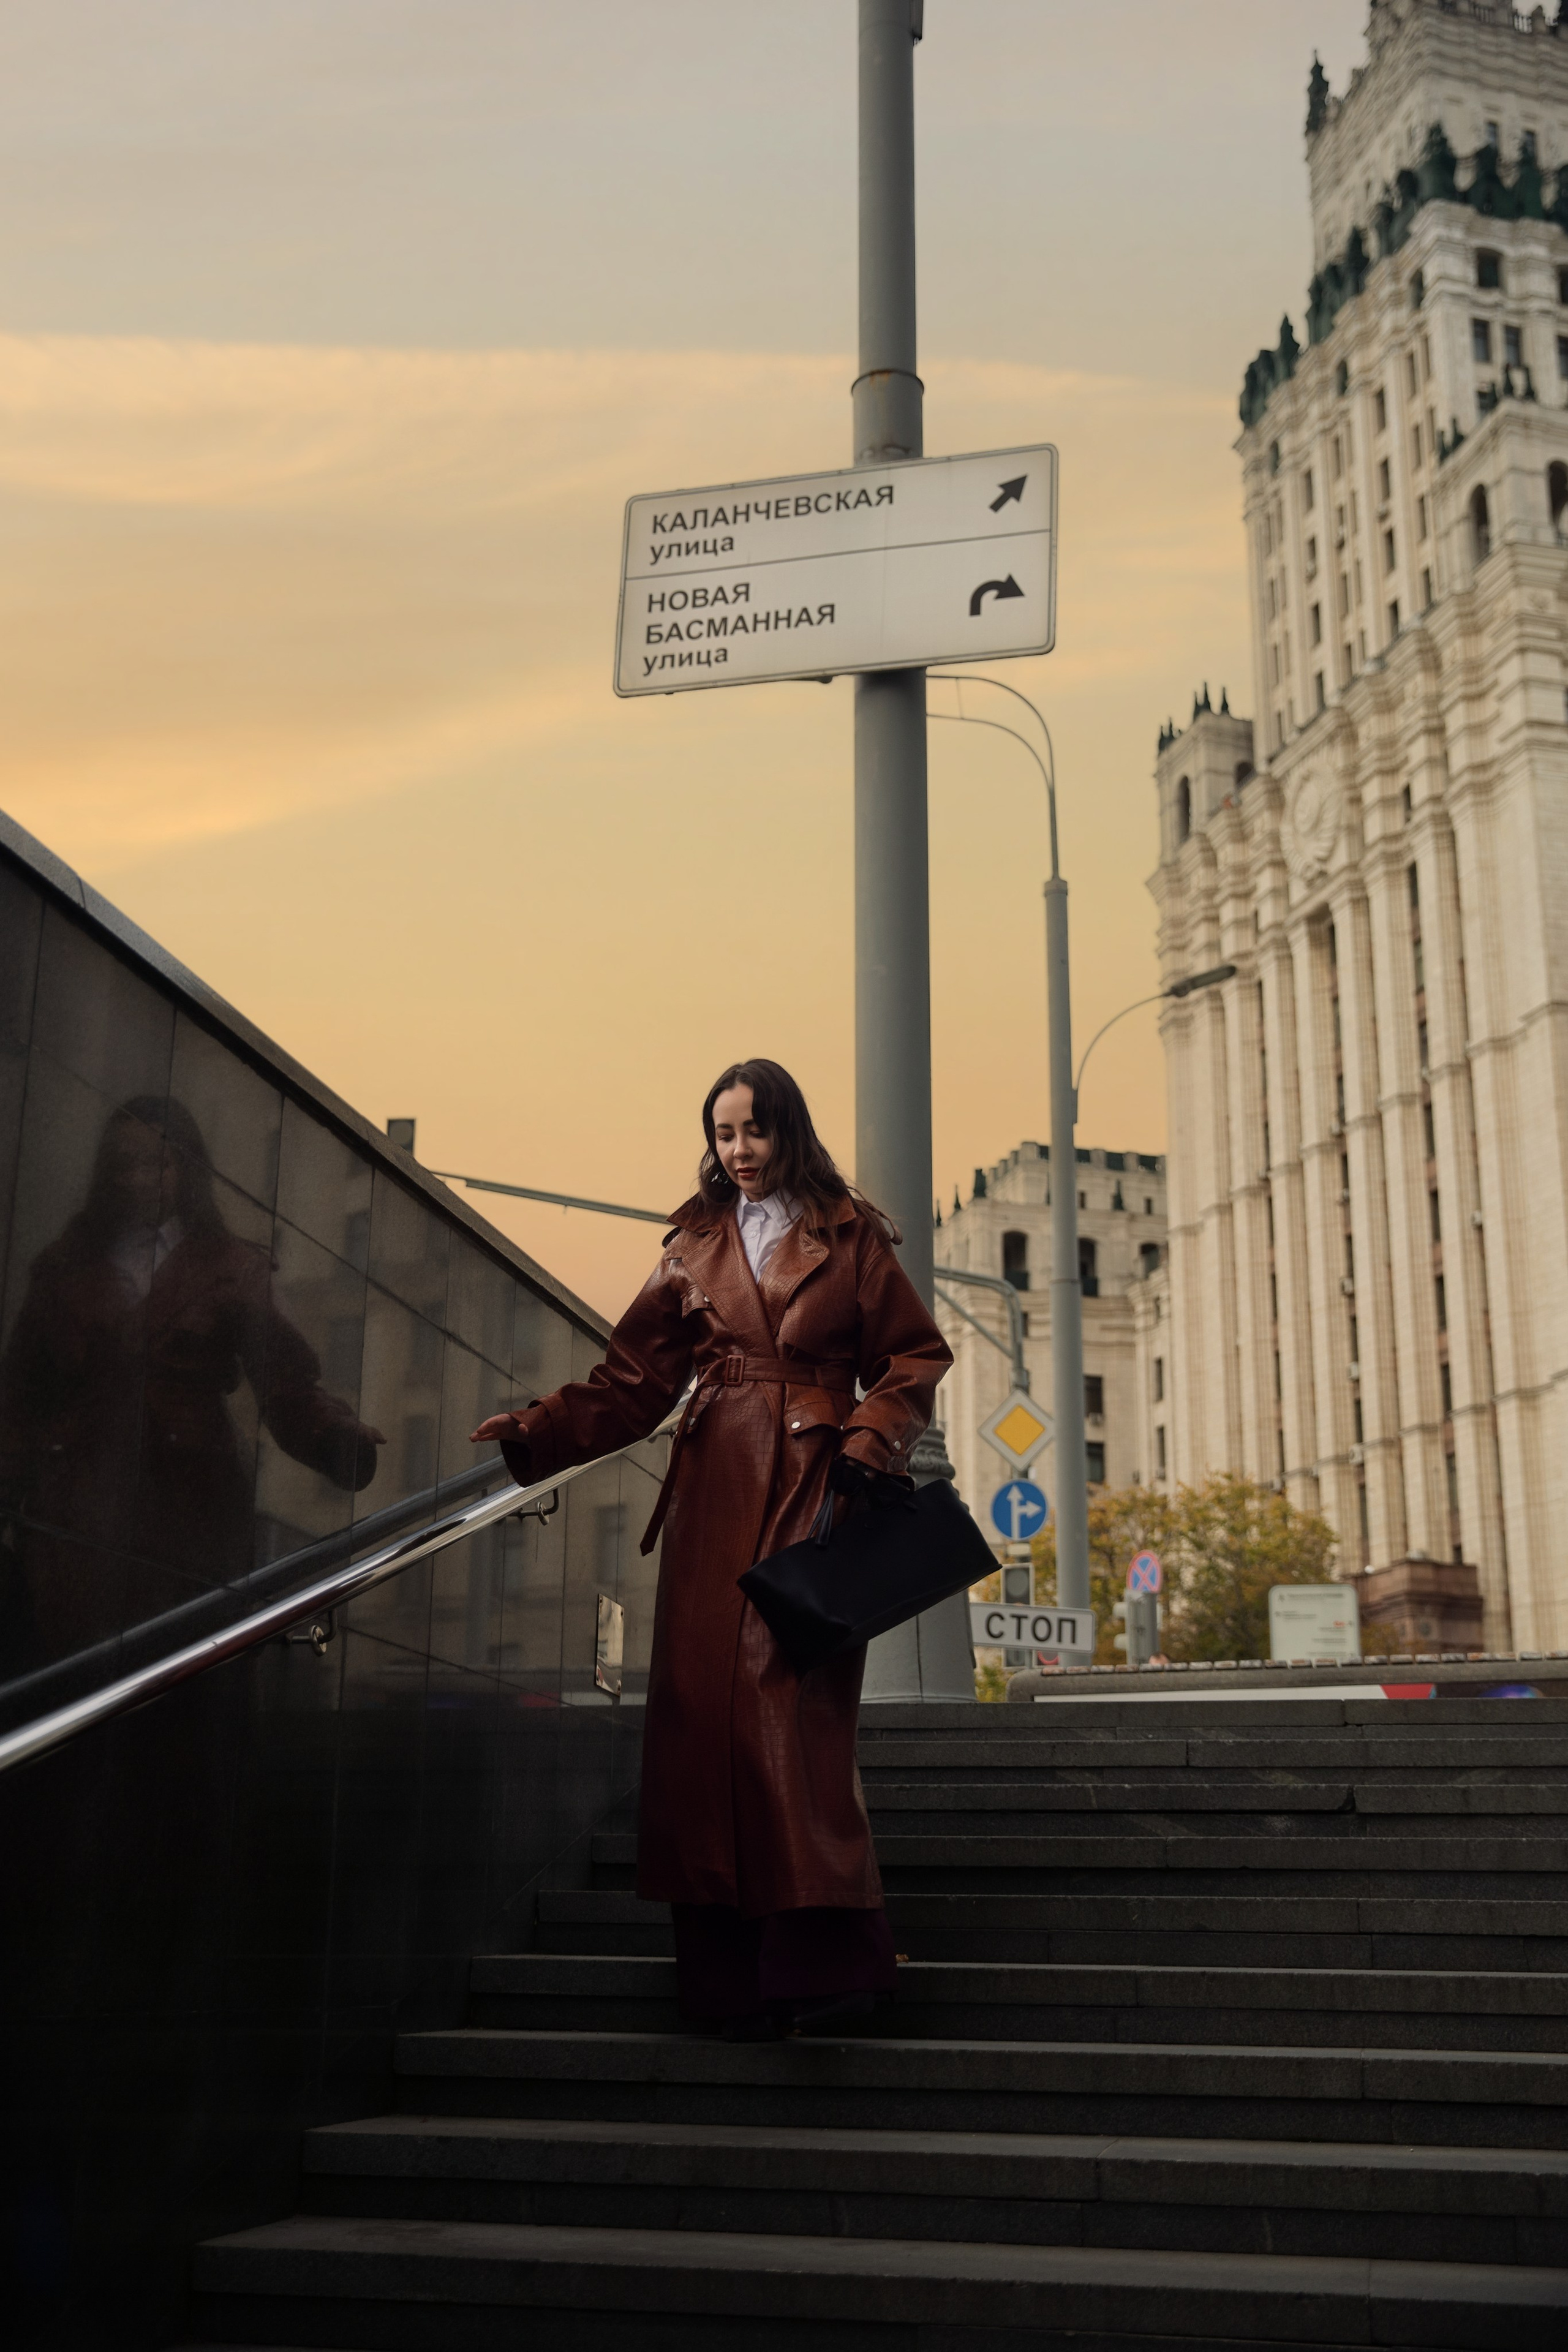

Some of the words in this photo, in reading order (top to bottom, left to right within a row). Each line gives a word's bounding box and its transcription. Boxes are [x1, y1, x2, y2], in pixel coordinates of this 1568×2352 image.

[652, 484, 894, 535] КАЛАНЧЕВСКАЯ
[649, 535, 734, 566] улица
[647, 582, 750, 614] НОВАЯ
[645, 603, 836, 646] БАСМАННАЯ
[643, 647, 728, 677] улица
[984, 1611, 1077, 1645] СТОП
